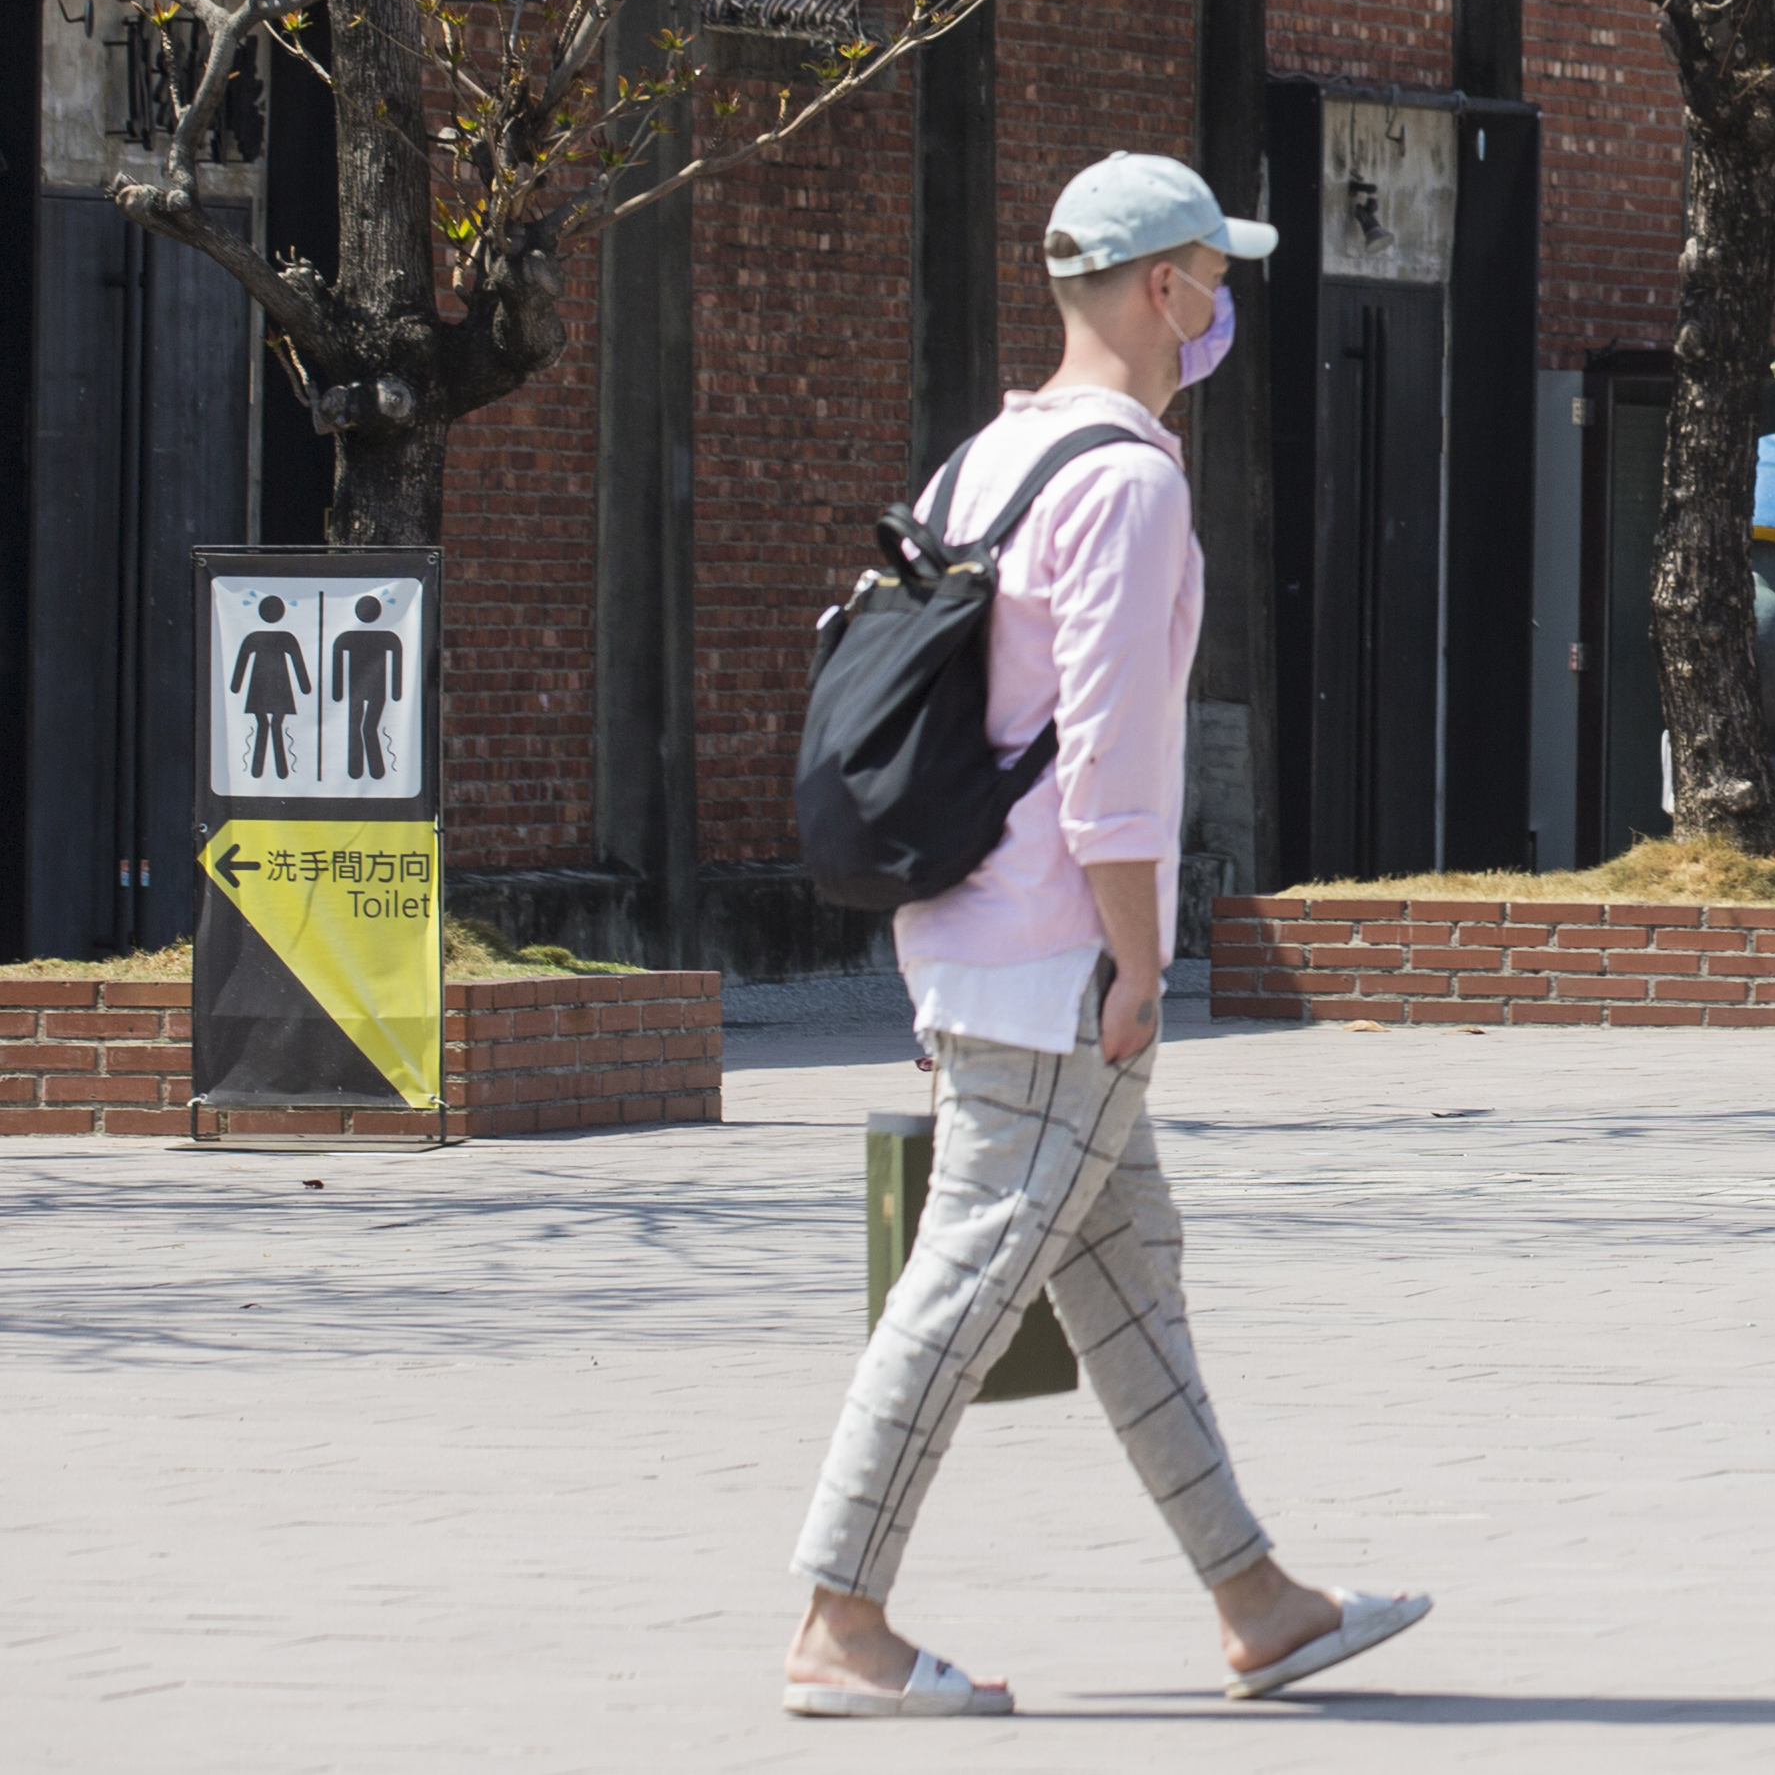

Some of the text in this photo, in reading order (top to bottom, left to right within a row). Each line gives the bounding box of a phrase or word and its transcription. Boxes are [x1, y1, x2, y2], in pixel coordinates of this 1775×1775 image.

[267, 849, 431, 883] 洗手間方向
[347, 890, 431, 918] Toilet
